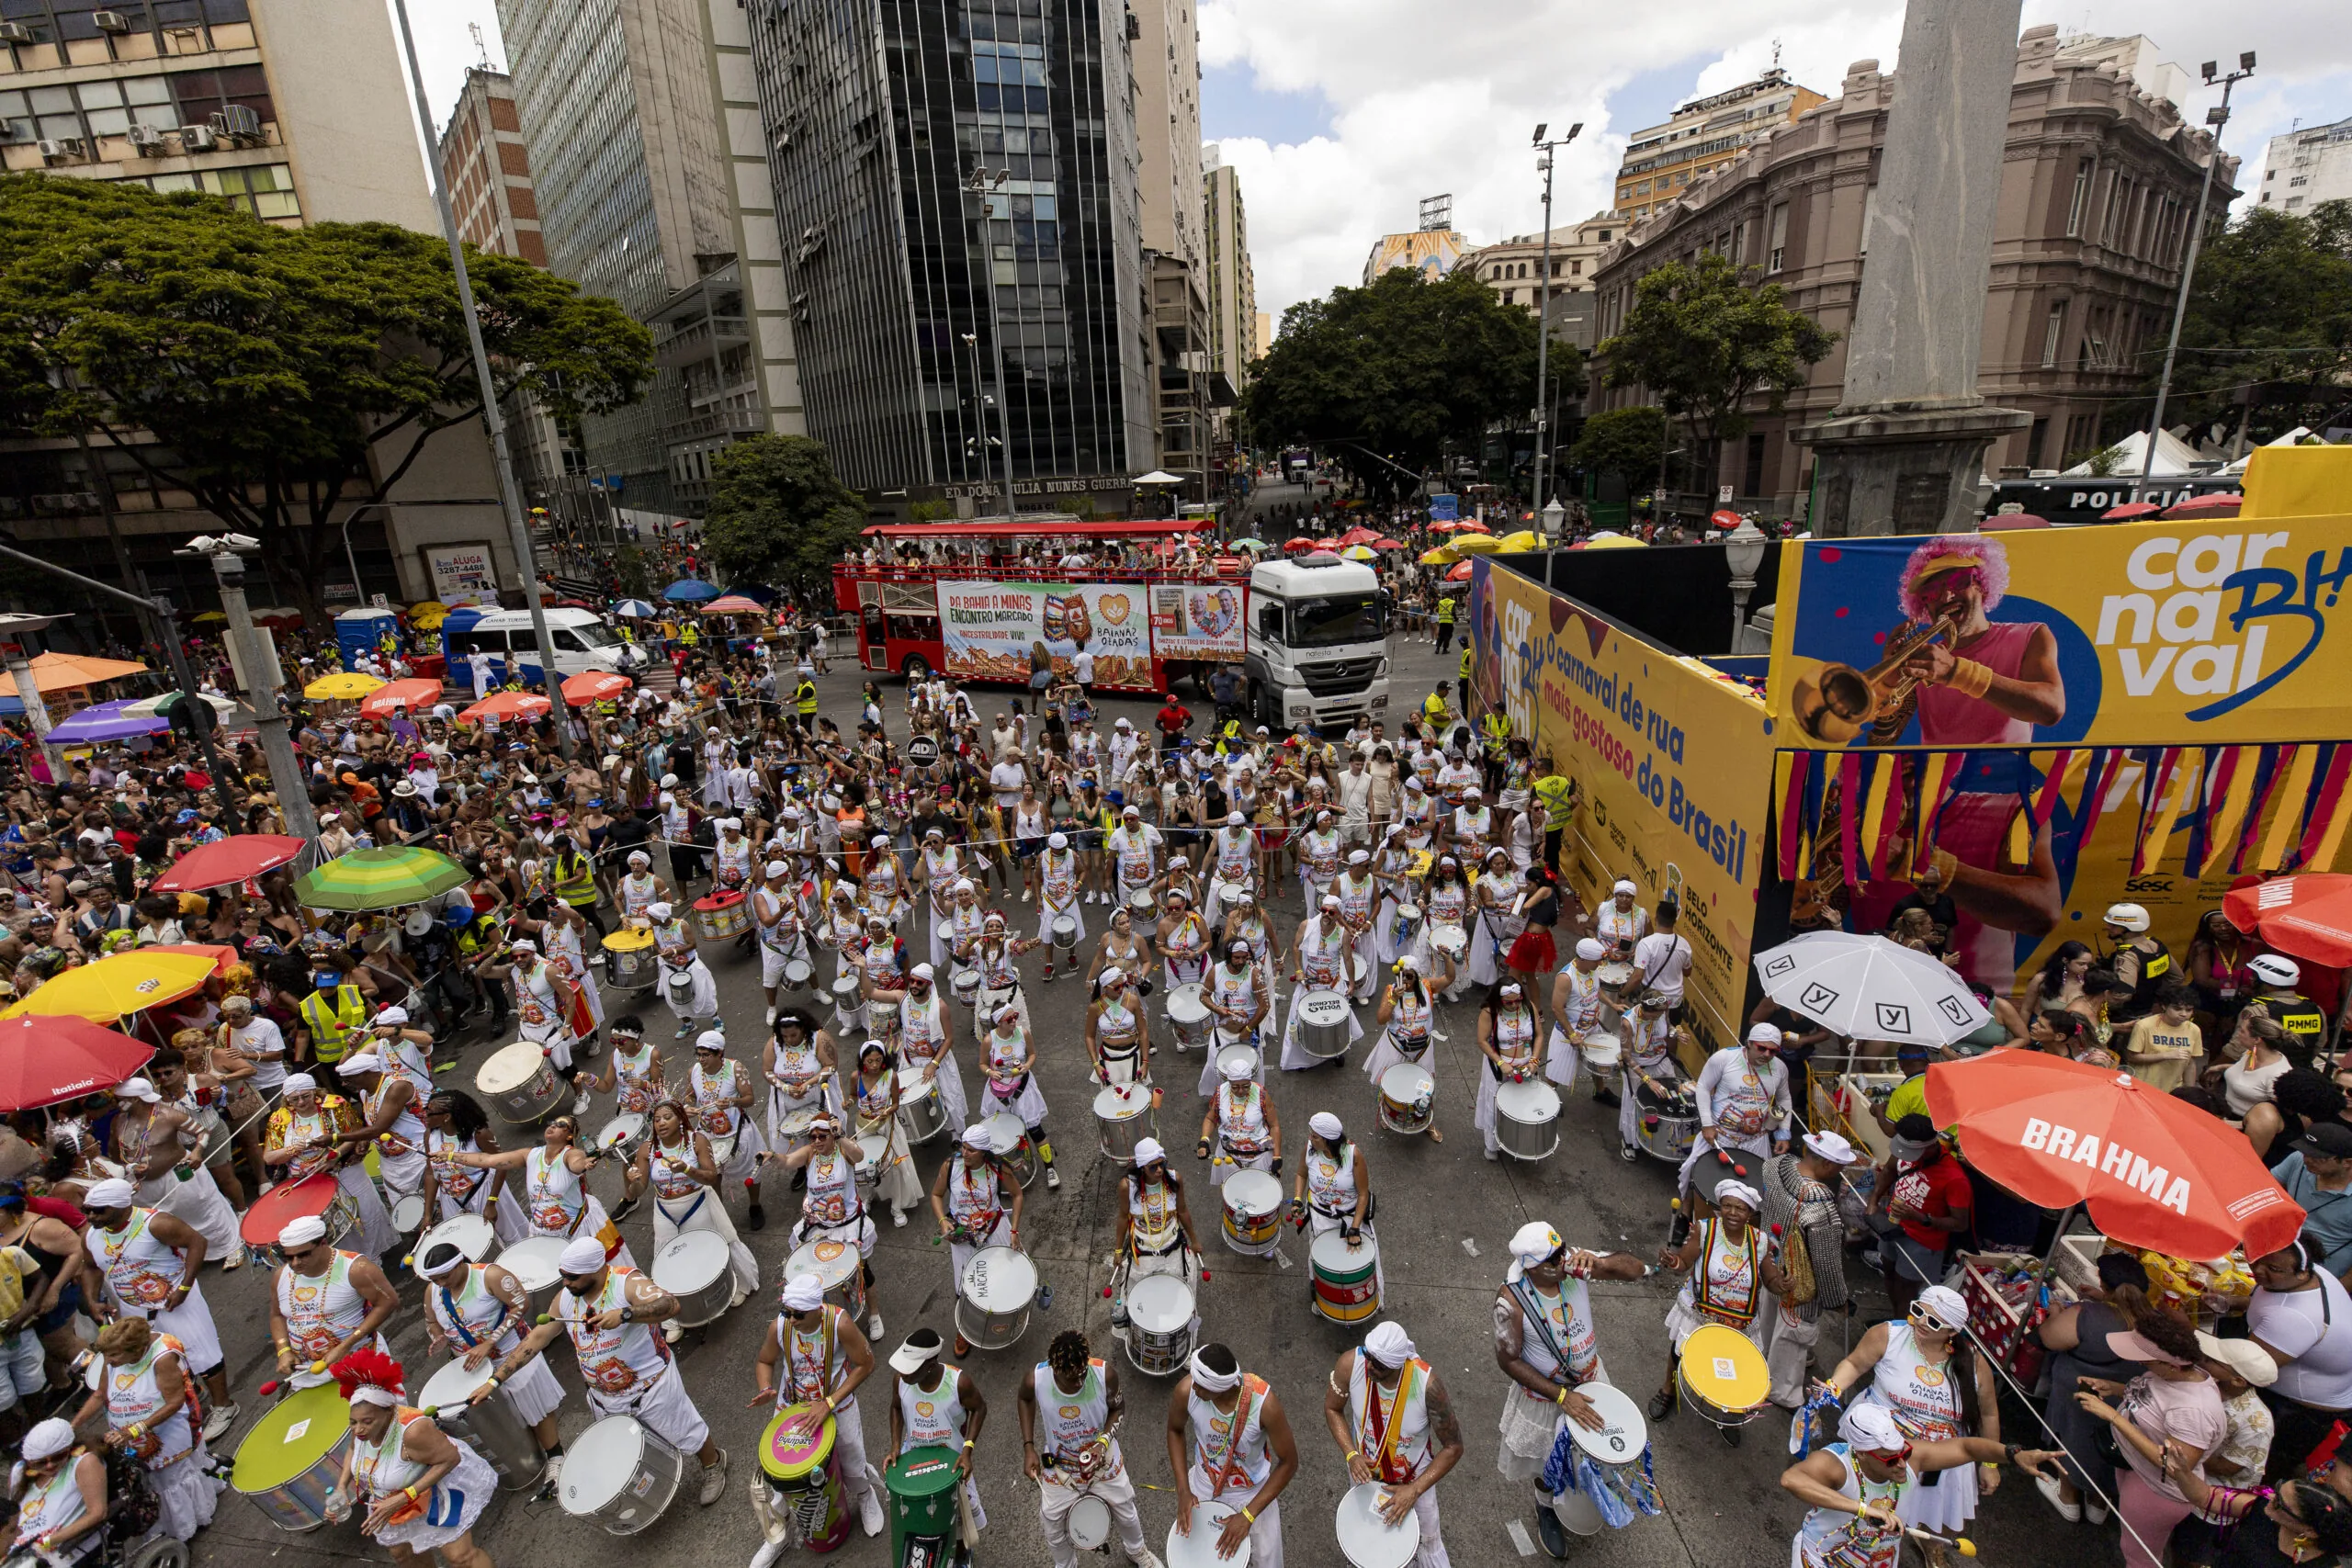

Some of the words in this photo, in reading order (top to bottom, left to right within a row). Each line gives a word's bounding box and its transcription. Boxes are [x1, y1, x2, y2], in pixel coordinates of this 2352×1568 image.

[967, 485, 1001, 498] DONA
[1046, 479, 1085, 492] NUNES
[1091, 477, 1135, 490] GUERRA
[2070, 489, 2191, 508] POLÍCIA
[437, 564, 485, 575] 3287-4488
[453, 556, 482, 566] ALUGA
[2127, 531, 2290, 592] car
[950, 595, 962, 607] DA
[965, 596, 989, 609] BAHIA
[993, 595, 999, 608] A
[1001, 594, 1033, 611] MINAS
[950, 608, 993, 625] ENCONTRO
[995, 611, 1033, 622] MARCADO
[1154, 616, 1162, 625] 70
[2095, 592, 2224, 645] na
[959, 629, 1009, 640] ANCESTRALIDADE
[1010, 631, 1025, 641] VIVA
[2117, 626, 2268, 697] val
[371, 697, 405, 710] BRAHMA
[1547, 632, 1555, 664] O
[1557, 647, 1617, 714] carnaval
[1621, 682, 1643, 732] de
[1647, 709, 1685, 766] rua
[909, 743, 929, 754] AD
[1544, 679, 1571, 724] mais
[1572, 705, 1634, 781] gostoso
[1637, 752, 1665, 808] do
[1668, 775, 1747, 886] Brasil
[1686, 886, 1708, 919] BELO
[1684, 905, 1733, 974] HORIZONTE
[1683, 921, 1710, 959] PREFEITURA
[1710, 953, 1717, 967] DO
[1717, 962, 1731, 986] POVO
[1702, 971, 1713, 993] NÃO
[1713, 987, 1728, 1011] PARA
[2287, 1020, 2318, 1030] PMMG
[2153, 1034, 2190, 1047] BRASIL
[2021, 1117, 2190, 1216] BRAHMA
[976, 1260, 989, 1298] MARCATTO
[600, 1337, 621, 1349] MINAS
[1901, 1397, 1928, 1410] BAHIA
[778, 1435, 816, 1449] Azedinha
[905, 1462, 948, 1478] icekiss
